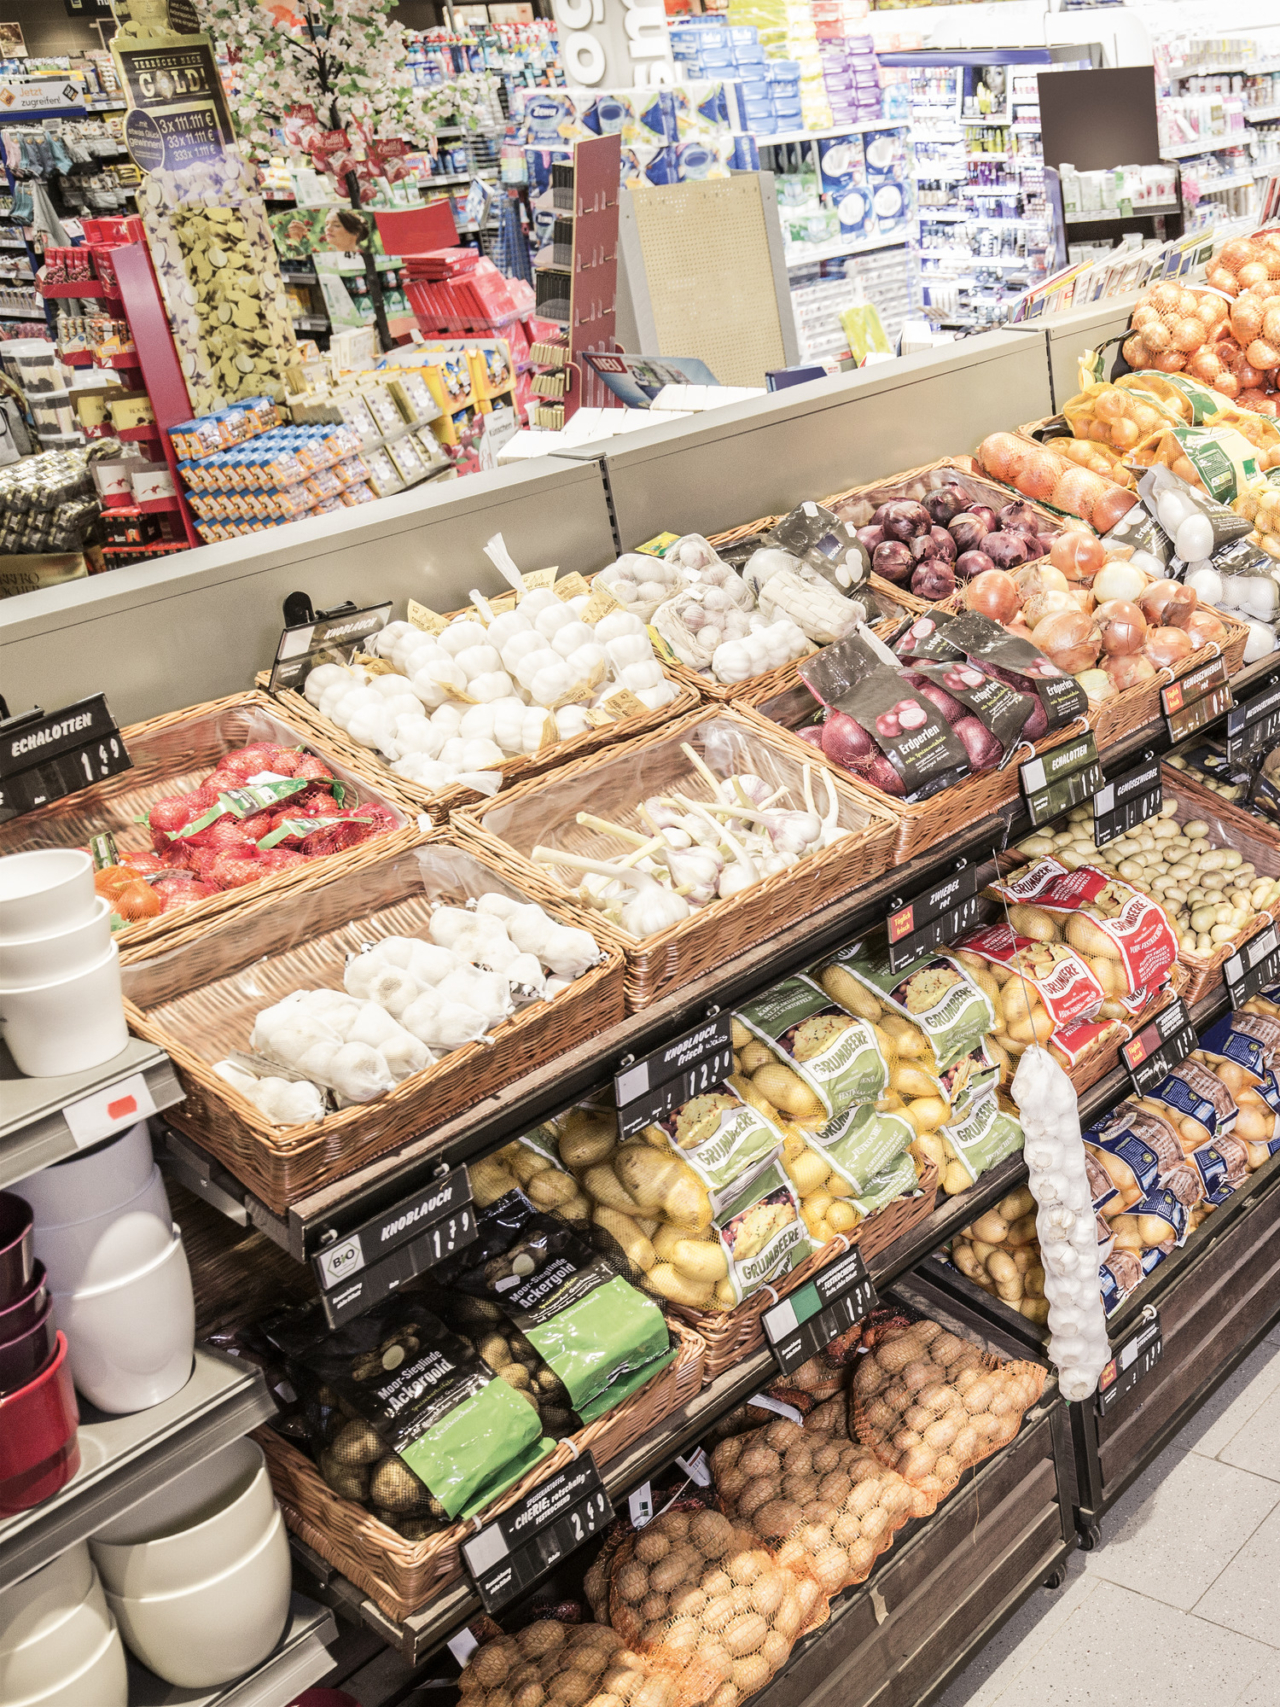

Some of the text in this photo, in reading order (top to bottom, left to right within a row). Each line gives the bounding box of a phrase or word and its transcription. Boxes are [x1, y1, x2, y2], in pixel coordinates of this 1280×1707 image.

[134, 57, 177, 70] VERRÜCKT
[20, 88, 43, 97] Jetzt
[138, 67, 209, 98] GLD!
[205, 112, 214, 126] €
[533, 103, 558, 117] Zewa
[592, 357, 623, 372] NEU
[1046, 678, 1075, 697] Erdperlen
[11, 712, 93, 757] ECHALOTTEN
[898, 725, 941, 757] Erdperlen
[1052, 744, 1088, 772] ECHALOTTEN
[929, 879, 960, 906] ZWIEBEL
[893, 912, 912, 927] Täglich
[896, 923, 911, 936] frisch
[924, 986, 977, 1029] GRUMBEERE
[664, 1023, 718, 1063] KNOBLAUCH
[677, 1043, 704, 1067] frisch
[812, 1029, 869, 1076] GRUMBEERE
[697, 1112, 757, 1166] GRUMBEERE
[381, 1187, 453, 1242] KNOBLAUCH
[741, 1227, 800, 1281] GRUMBEERE
[509, 1257, 568, 1302] Moor-Sieglinde
[519, 1262, 577, 1308] Ackergold
[378, 1350, 443, 1400] Moor-Sieglinde
[388, 1358, 455, 1411] Ackergold
[551, 1473, 587, 1504] rotschalig
